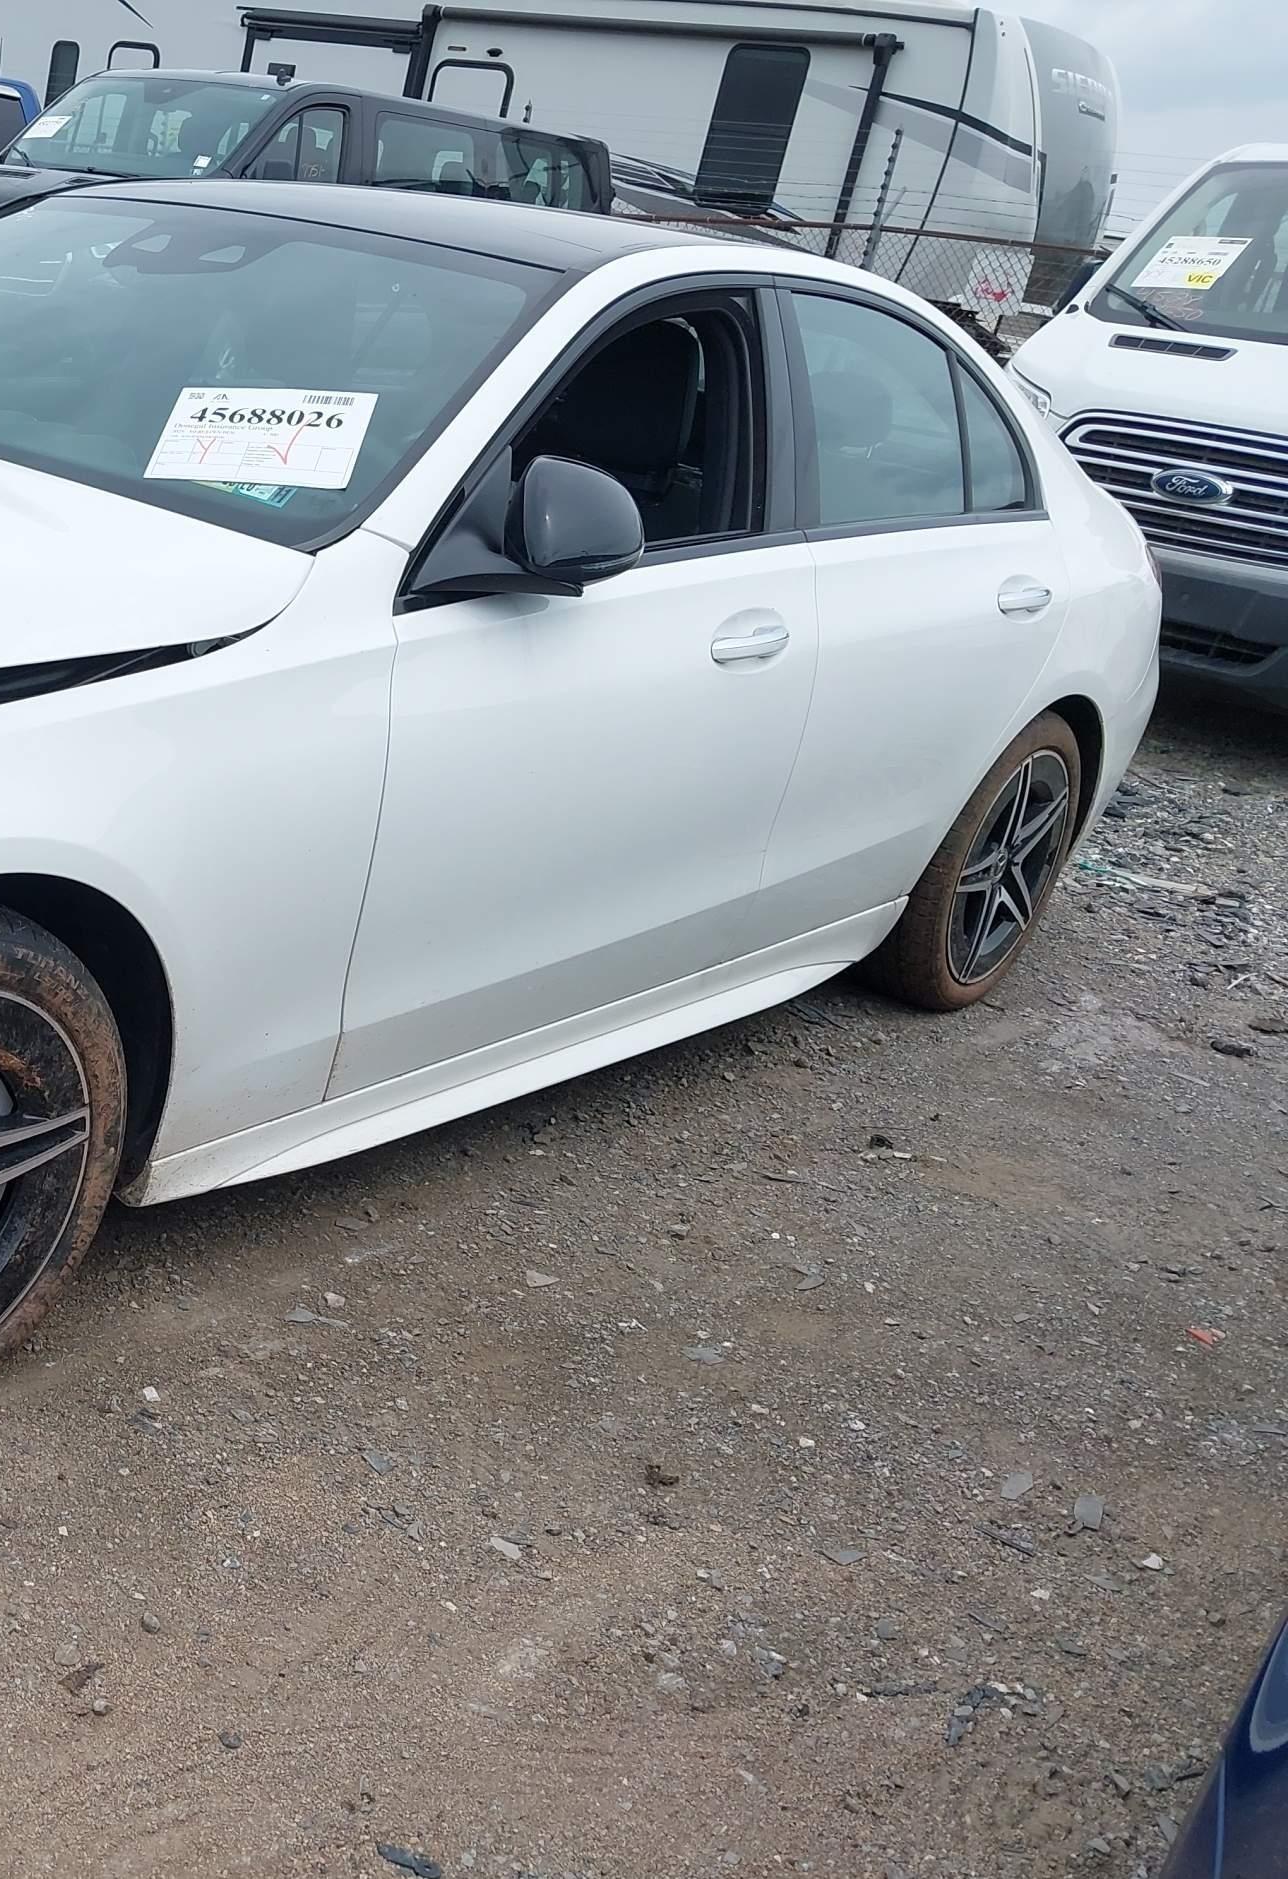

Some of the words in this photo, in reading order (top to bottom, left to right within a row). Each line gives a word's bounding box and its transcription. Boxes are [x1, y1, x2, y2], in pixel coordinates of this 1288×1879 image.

[1159, 256, 1223, 266] 45288650
[1187, 274, 1214, 284] VIC
[190, 407, 345, 430] 45688026
[1165, 476, 1209, 496] Ford
